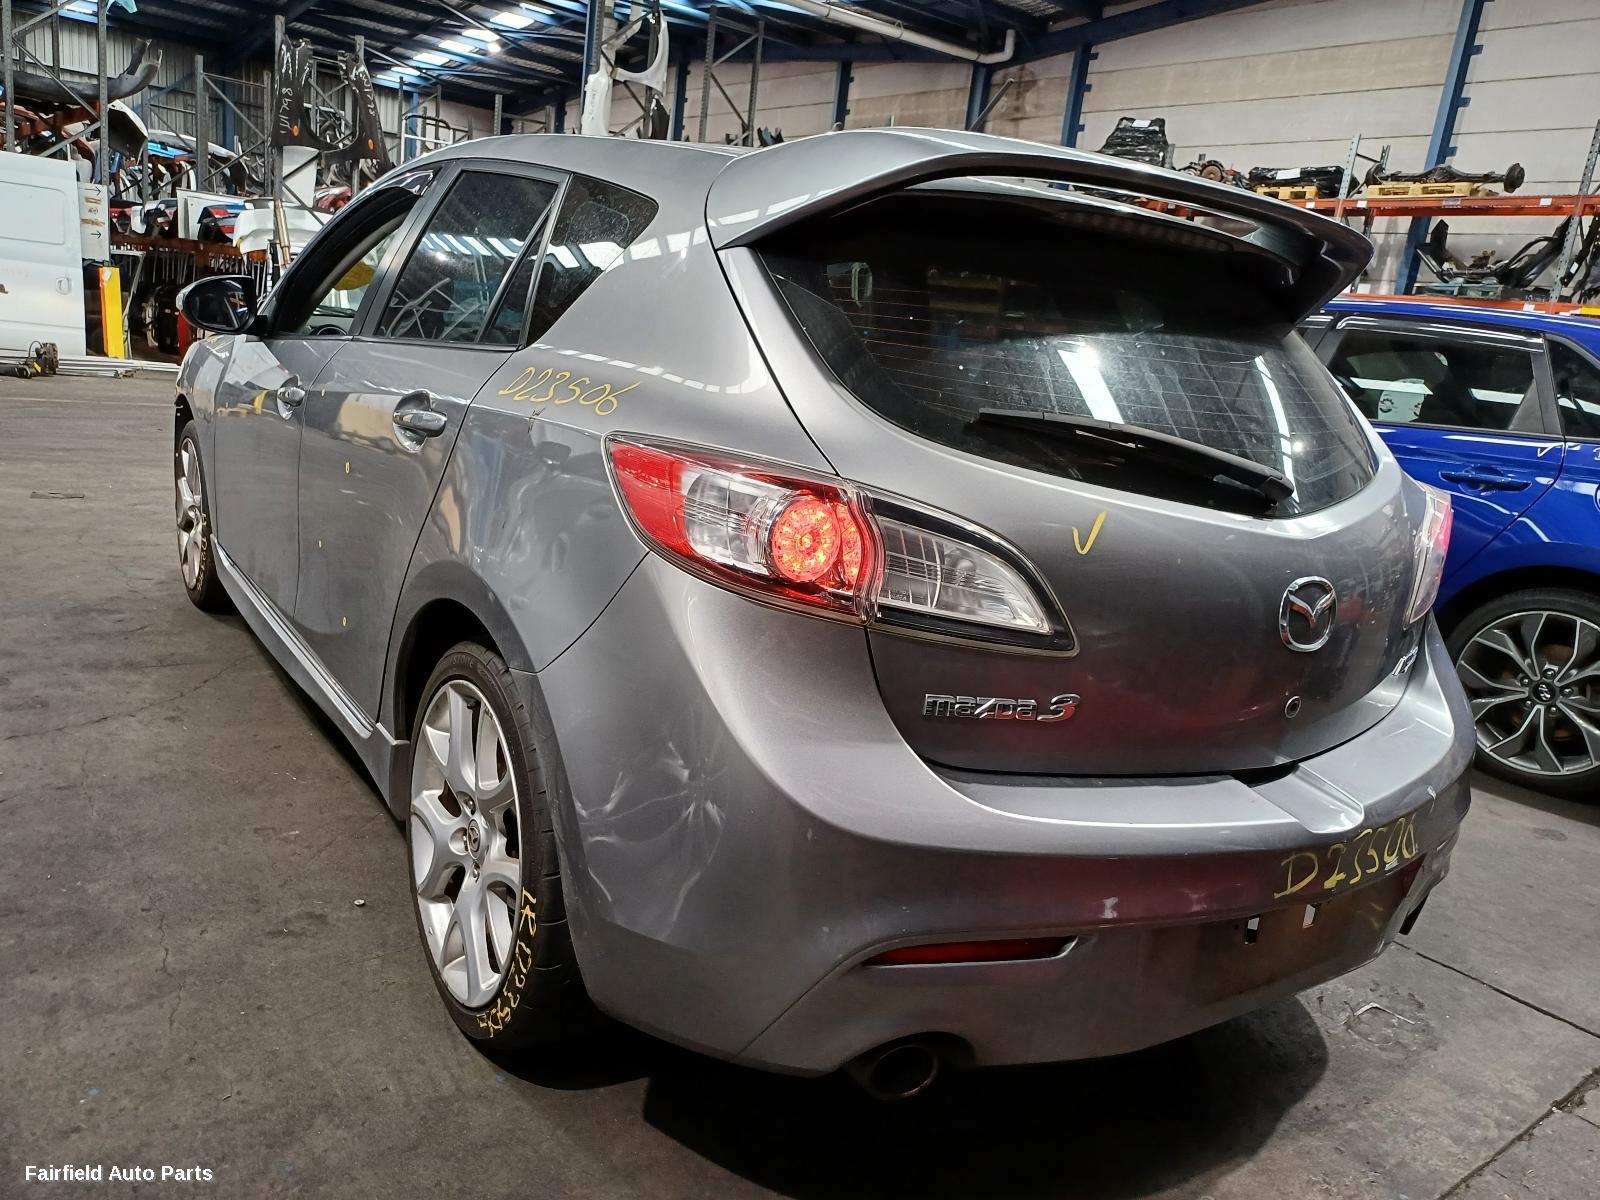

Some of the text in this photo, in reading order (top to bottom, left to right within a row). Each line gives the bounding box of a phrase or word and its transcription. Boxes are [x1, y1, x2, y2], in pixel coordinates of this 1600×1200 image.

[498, 366, 641, 417] D23506
[923, 693, 1081, 722] mazda 3
